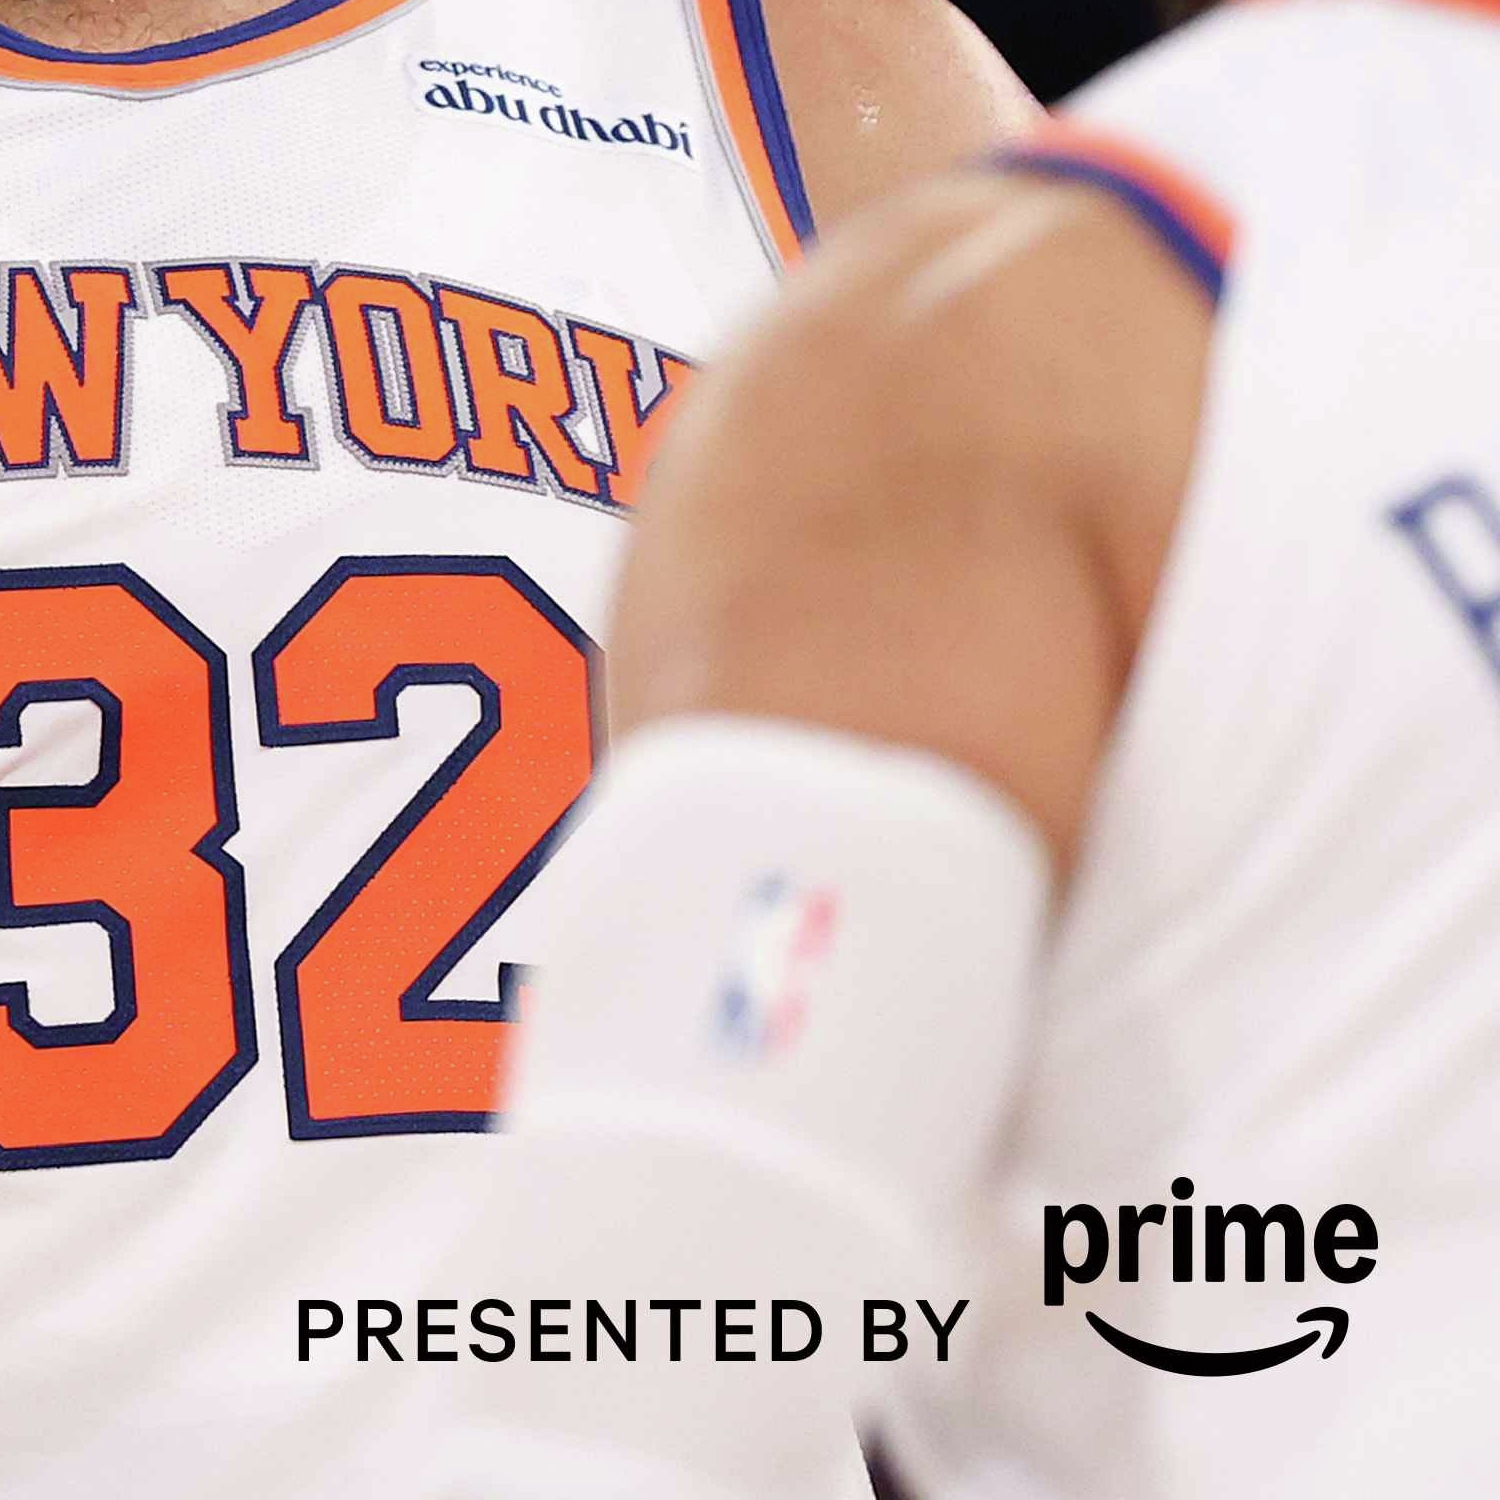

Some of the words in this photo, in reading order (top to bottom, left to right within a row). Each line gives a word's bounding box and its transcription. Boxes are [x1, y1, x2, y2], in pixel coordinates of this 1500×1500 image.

[419, 58, 564, 99] experience
[424, 79, 532, 125] abu
[539, 104, 694, 160] dhabi
